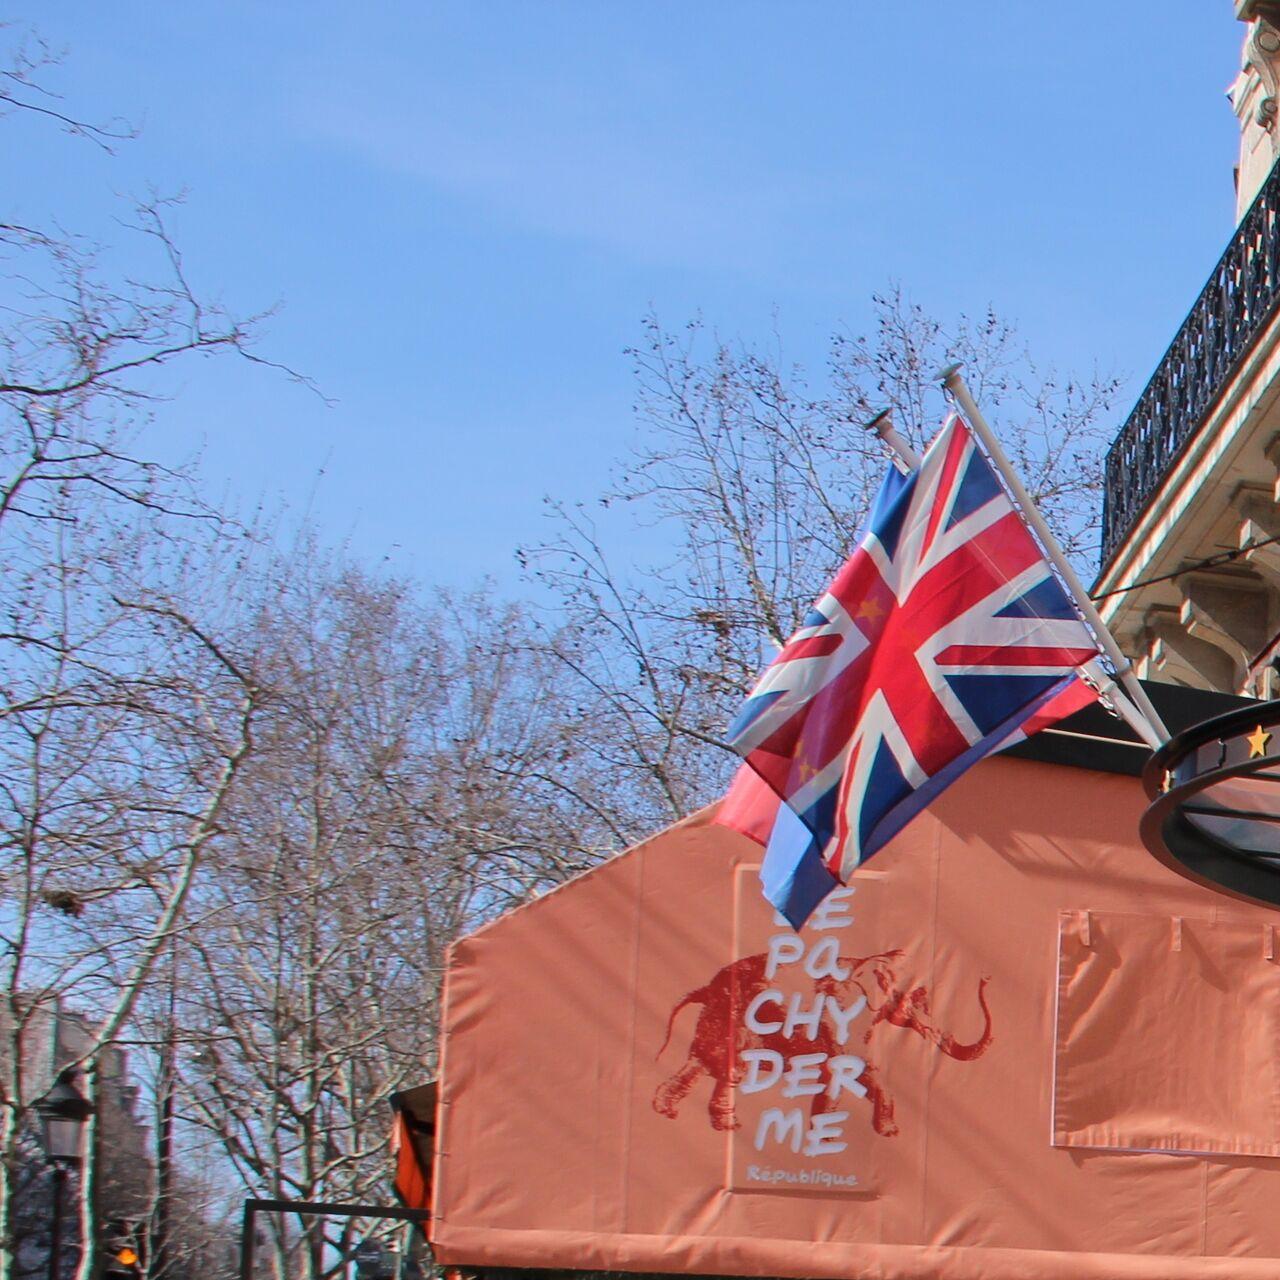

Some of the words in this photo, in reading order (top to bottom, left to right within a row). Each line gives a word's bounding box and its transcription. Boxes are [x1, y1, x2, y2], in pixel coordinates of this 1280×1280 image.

[773, 886, 857, 931] E
[744, 988, 868, 1046] CHY
[738, 1048, 868, 1100] DER
[753, 1106, 850, 1158] ME
[746, 1164, 859, 1187] République
